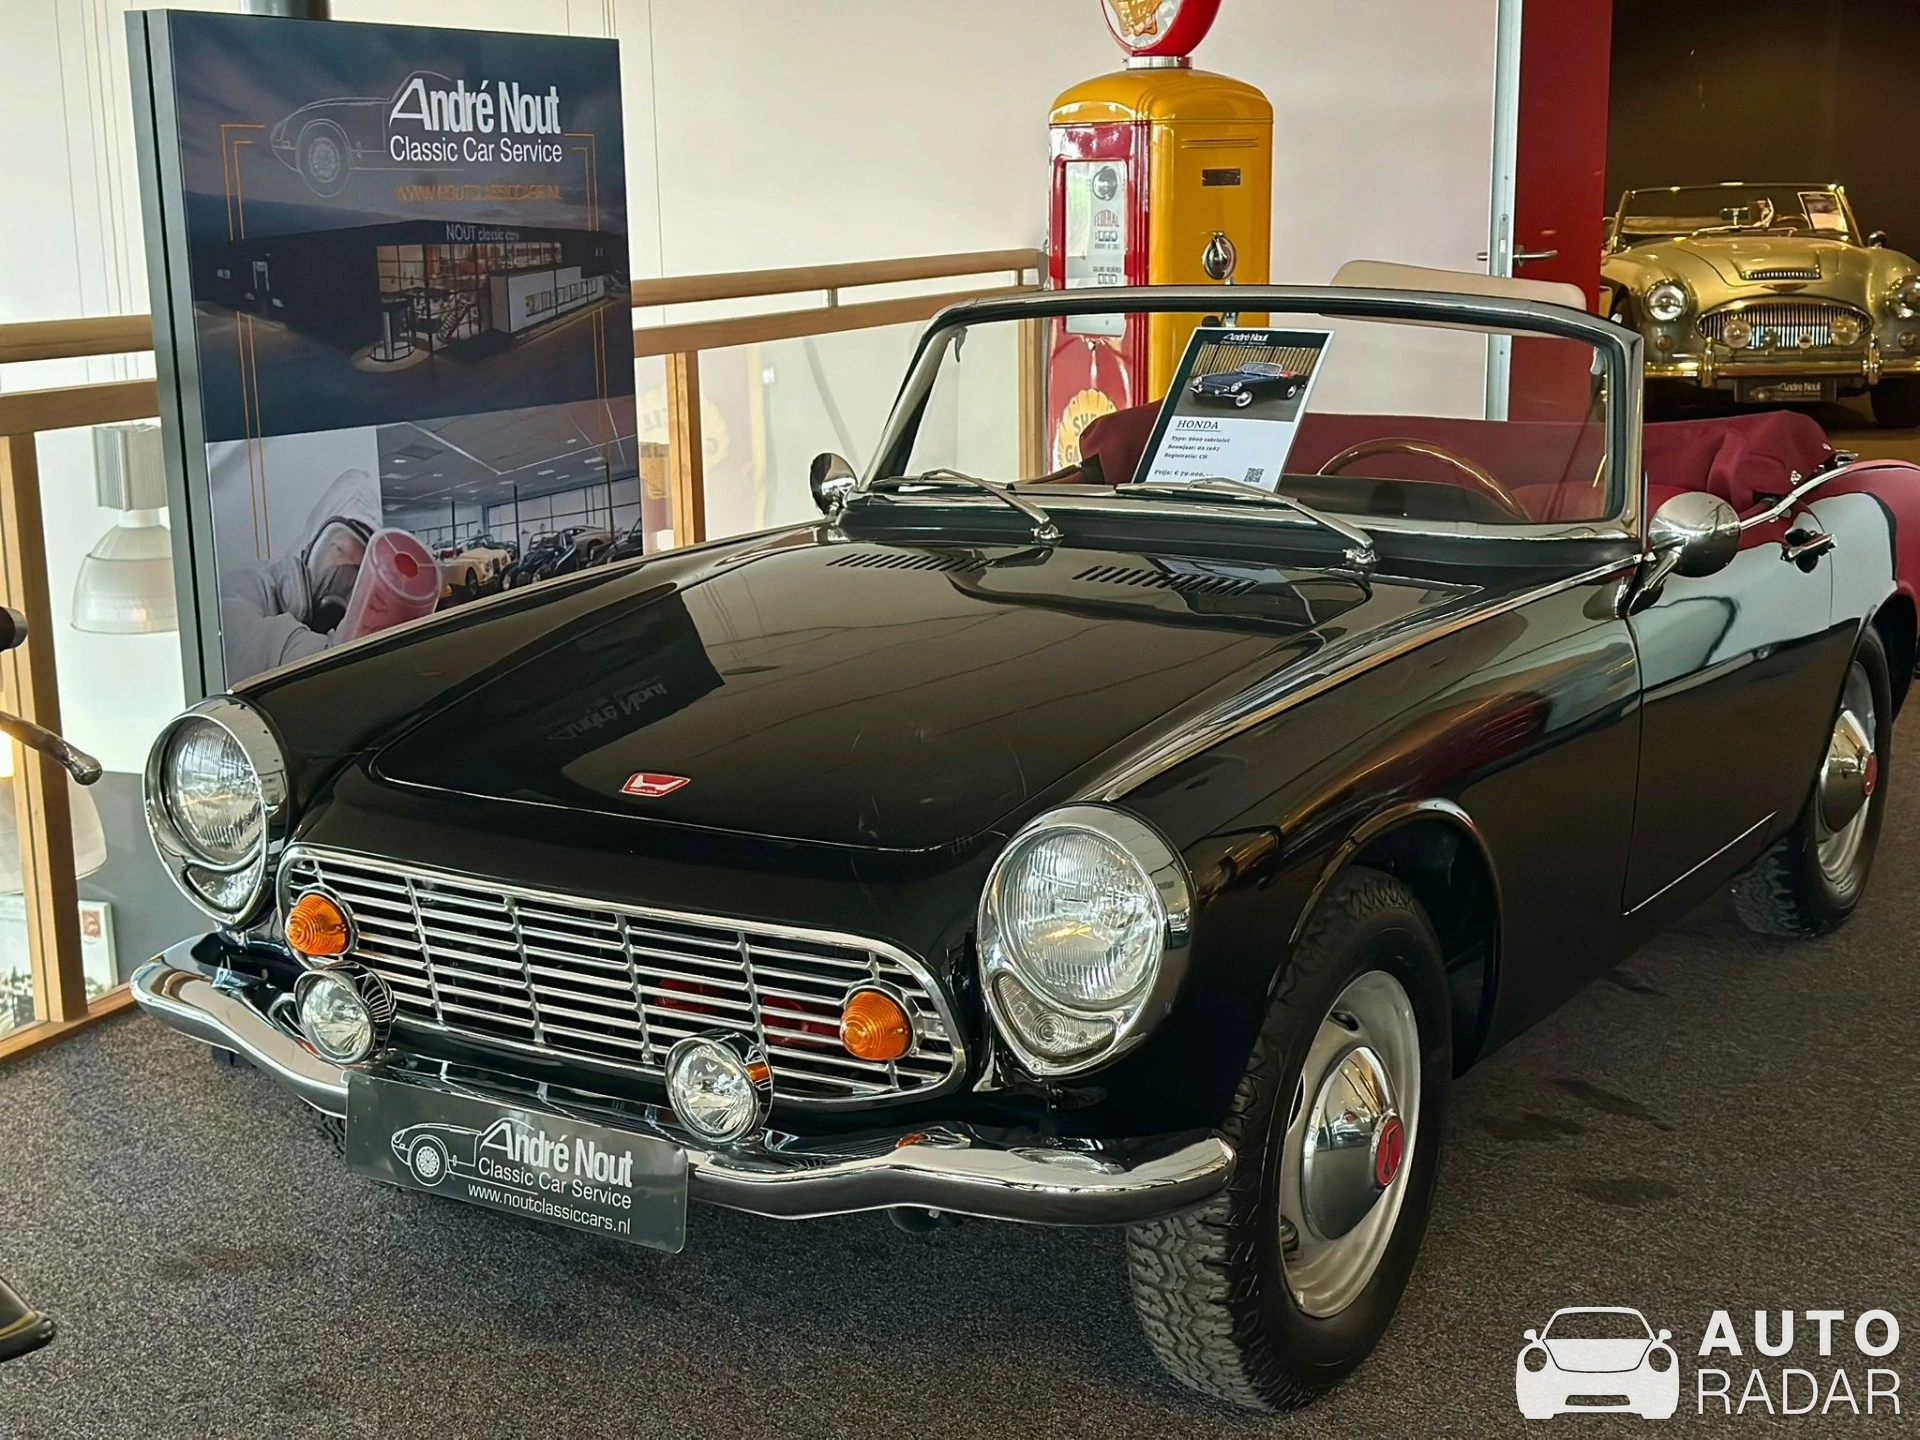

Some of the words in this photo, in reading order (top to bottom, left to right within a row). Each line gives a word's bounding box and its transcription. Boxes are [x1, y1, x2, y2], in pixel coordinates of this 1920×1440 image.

[389, 78, 495, 133] André
[498, 81, 562, 135] Nout
[390, 135, 459, 162] Classic
[463, 136, 495, 162] Car
[500, 137, 563, 163] Service
[446, 223, 476, 242] NOUT
[1177, 420, 1219, 430] HONDA
[479, 1122, 570, 1173] André
[574, 1138, 634, 1189] Nout
[468, 1183, 631, 1236] www.noutclassiccars.nl
[478, 1157, 535, 1187] Classic
[538, 1171, 567, 1195] Car
[571, 1178, 633, 1210] Service
